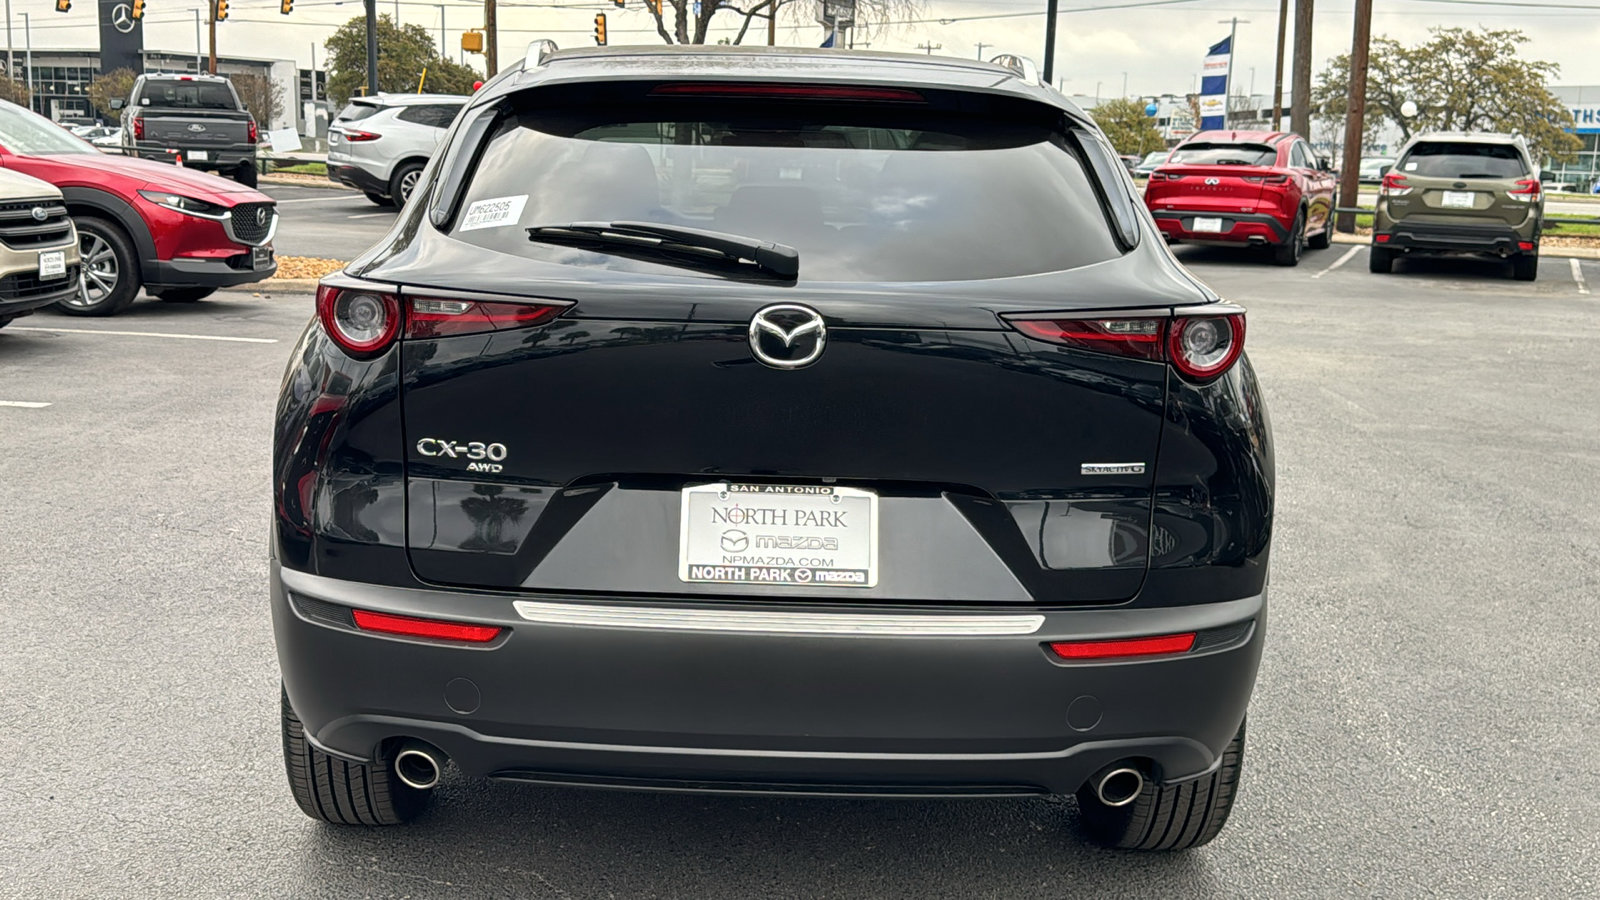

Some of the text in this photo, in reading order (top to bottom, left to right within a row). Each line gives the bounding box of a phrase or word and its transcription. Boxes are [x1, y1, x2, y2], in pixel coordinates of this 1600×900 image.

[416, 438, 507, 461] CX-30
[466, 462, 503, 473] AWD
[730, 484, 831, 494] SAN ANTONIO
[711, 506, 848, 528] NORTH PARK
[755, 535, 839, 551] mazda
[722, 555, 834, 567] NPMAZDA.COM
[691, 566, 865, 582] NORTH PARK mazda
